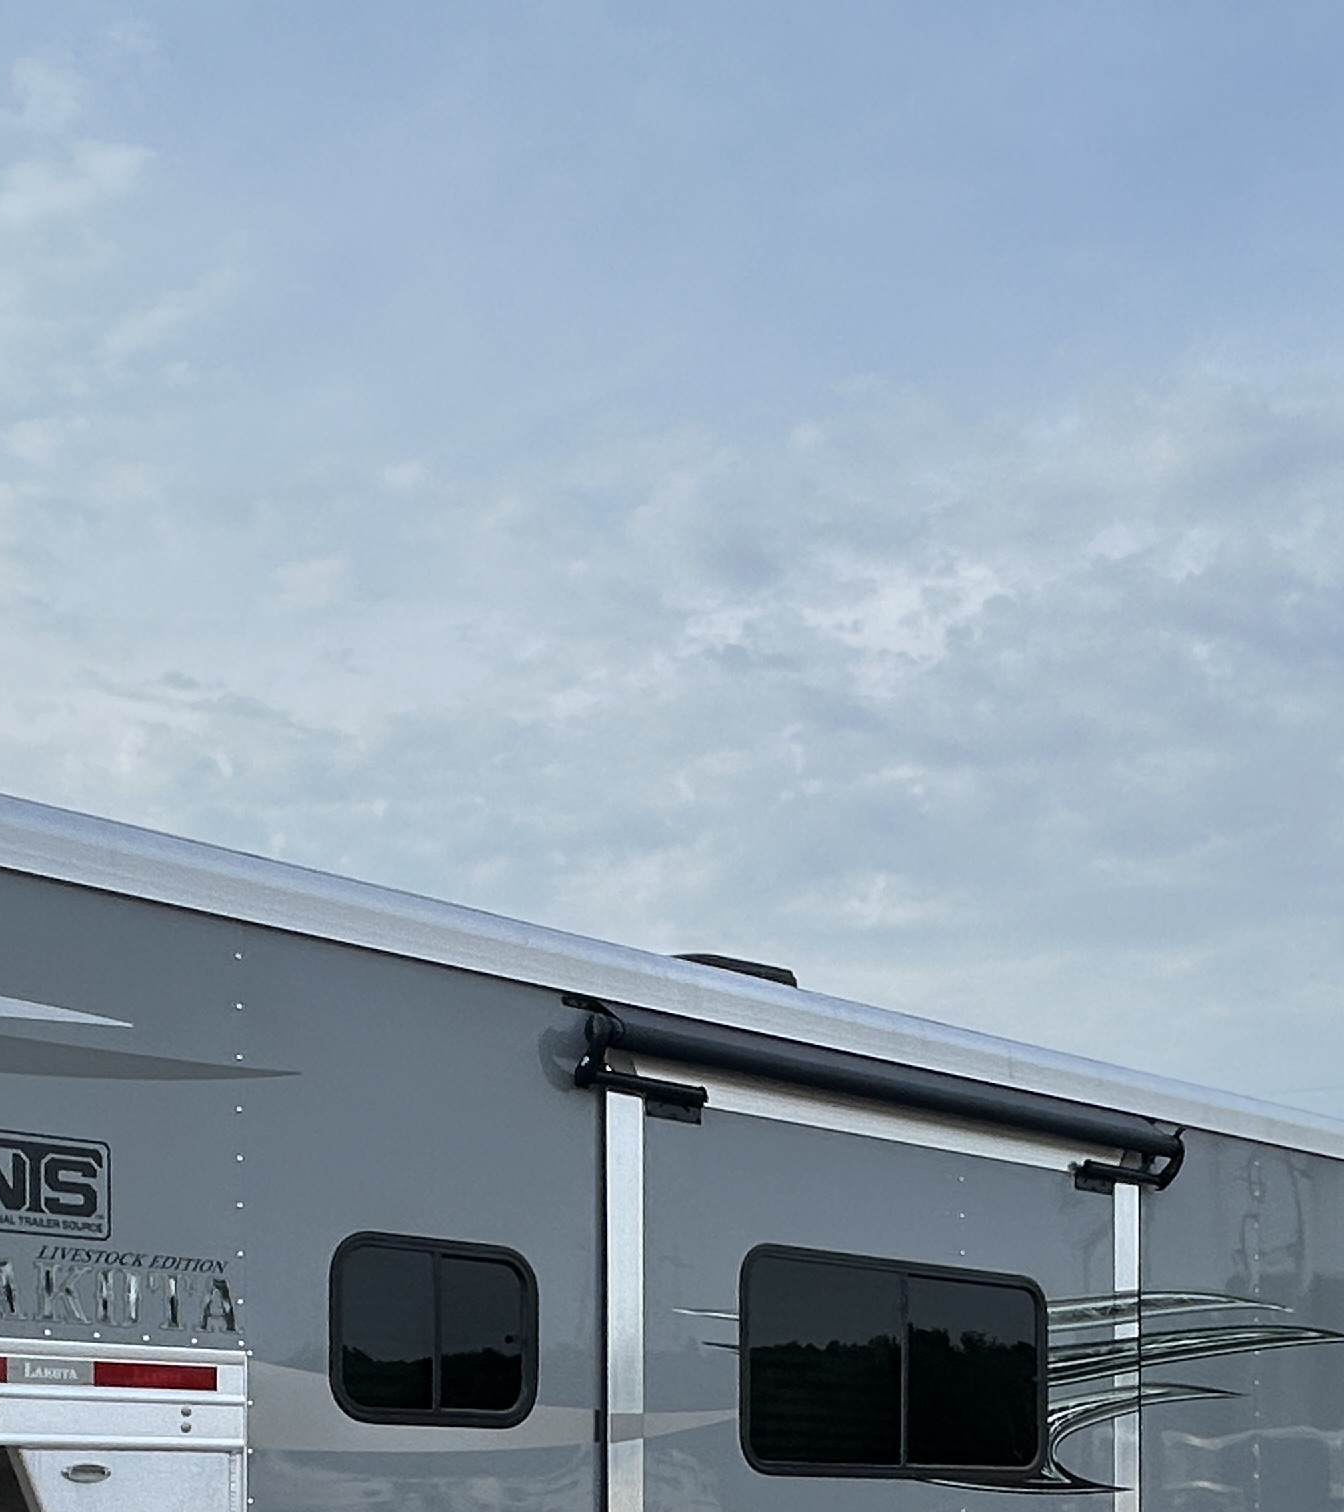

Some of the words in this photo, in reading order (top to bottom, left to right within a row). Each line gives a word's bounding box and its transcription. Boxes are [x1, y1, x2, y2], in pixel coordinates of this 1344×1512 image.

[18, 1215, 60, 1229] TRAILER
[62, 1220, 104, 1234] SOURCE
[35, 1244, 148, 1268] LIVESTOCK
[149, 1254, 229, 1274] EDITION
[23, 1361, 79, 1381] LAKOTA
